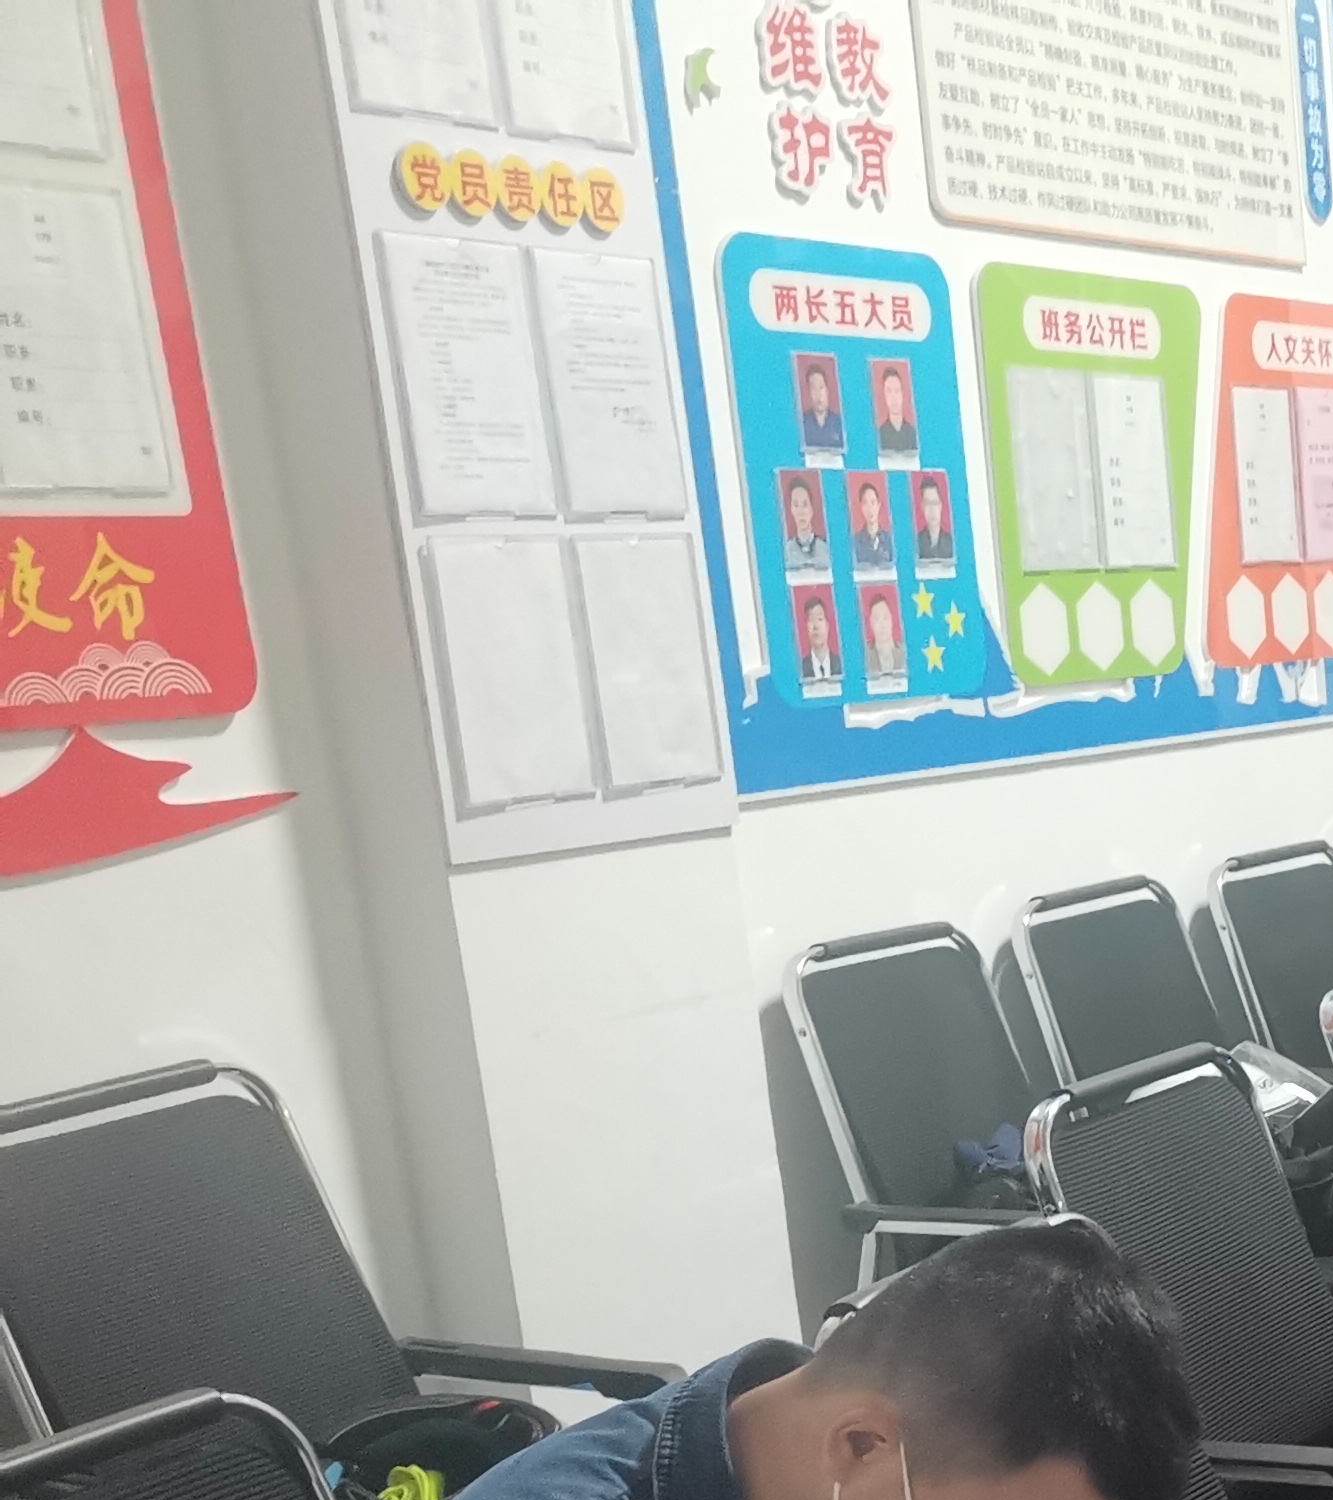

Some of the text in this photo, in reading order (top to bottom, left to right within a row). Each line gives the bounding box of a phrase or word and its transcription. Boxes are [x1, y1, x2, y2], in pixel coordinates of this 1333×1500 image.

[1300, 12, 1326, 202] 一切事故为零
[409, 153, 620, 223] 党员责任区
[772, 284, 914, 332] 两长五大员
[1039, 308, 1148, 351] 班务公开栏
